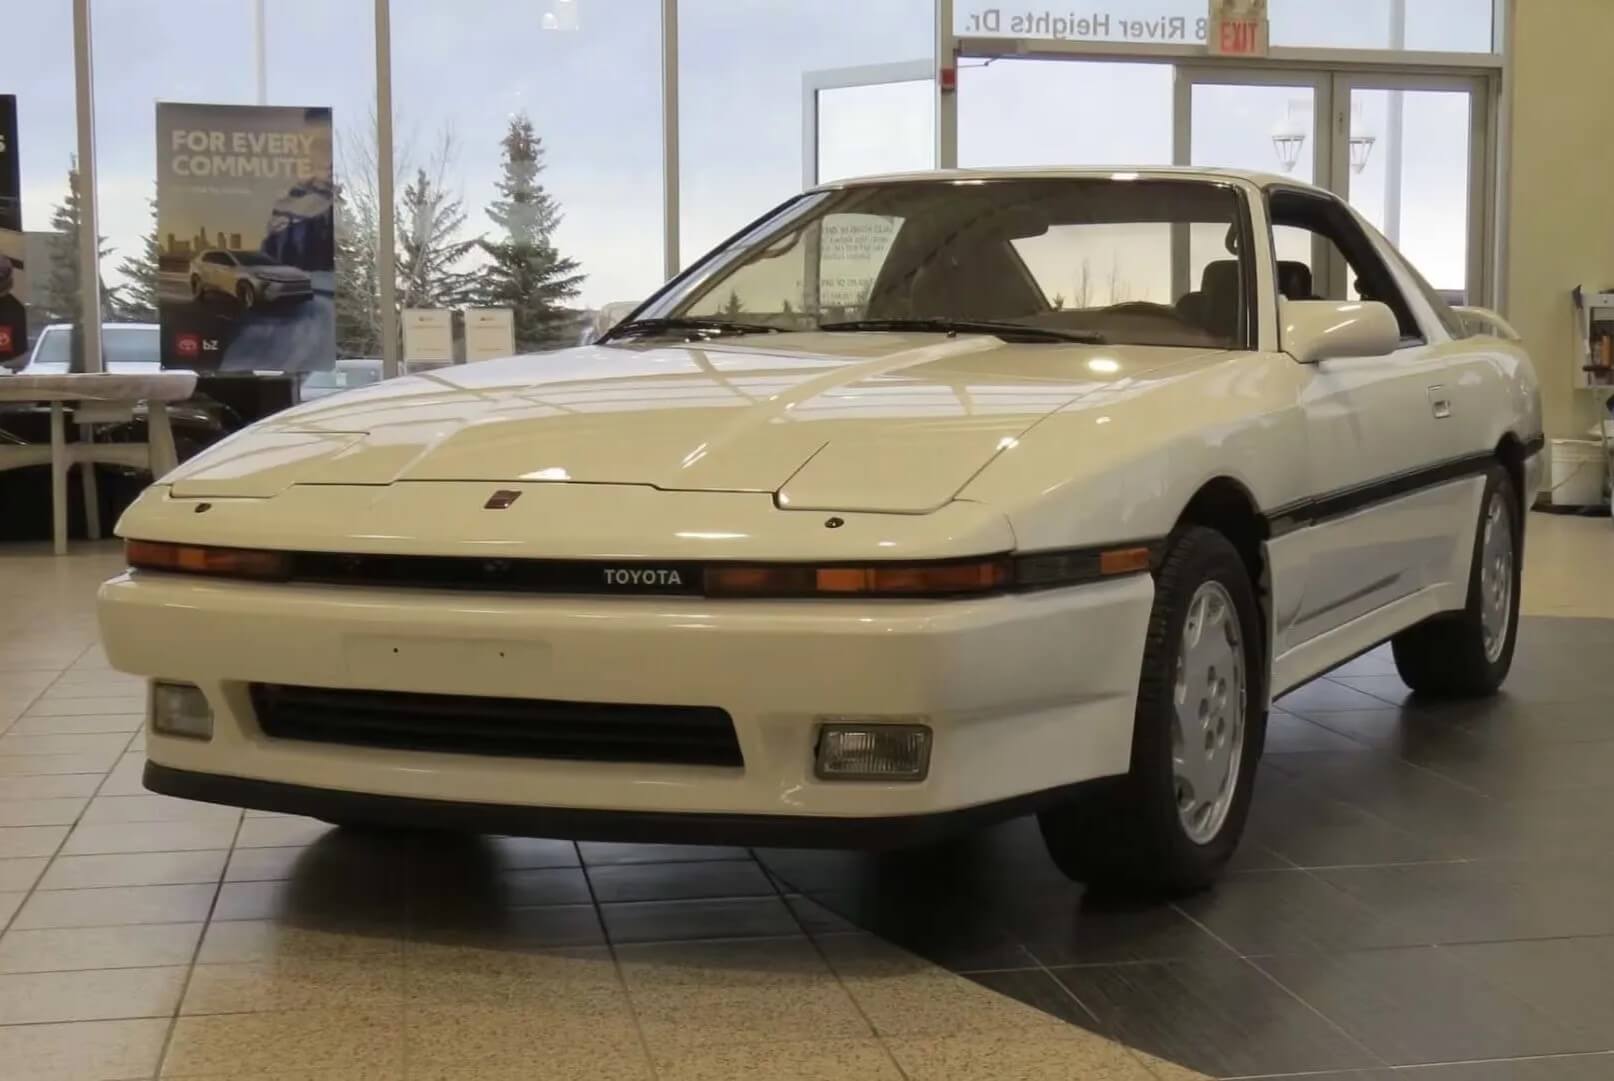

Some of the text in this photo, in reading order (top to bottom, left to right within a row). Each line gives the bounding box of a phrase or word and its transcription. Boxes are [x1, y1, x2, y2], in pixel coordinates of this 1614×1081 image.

[1221, 20, 1259, 52] EXIT
[171, 129, 314, 156] FOR EVERY
[172, 155, 313, 178] COMMUTE
[604, 568, 682, 585] TOYOTA
